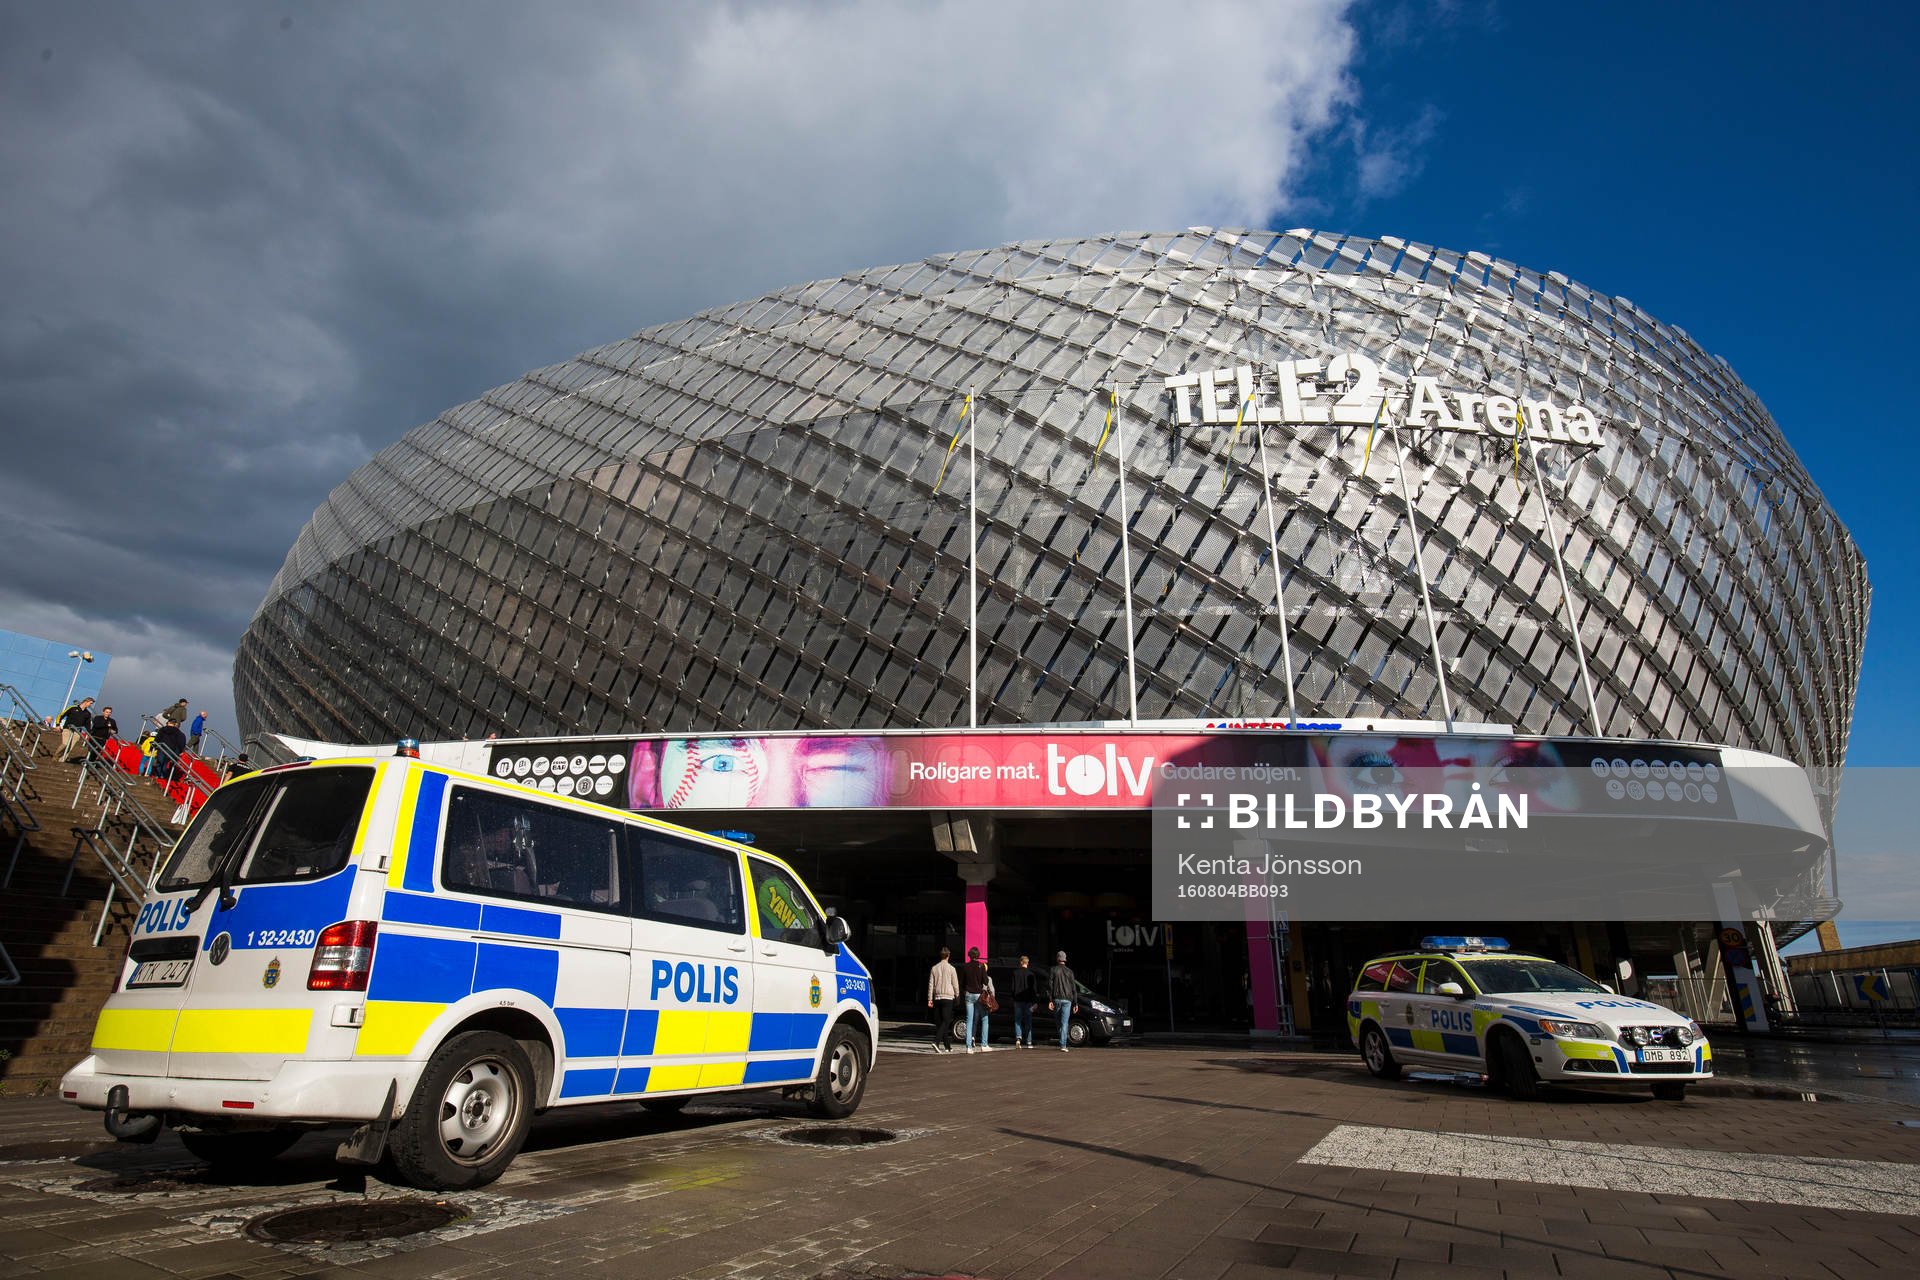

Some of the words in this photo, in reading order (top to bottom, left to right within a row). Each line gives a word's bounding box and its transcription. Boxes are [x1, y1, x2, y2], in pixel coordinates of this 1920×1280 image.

[1165, 353, 1388, 426] TELE2
[1405, 376, 1605, 447] Arena
[910, 762, 991, 783] Roligare
[996, 762, 1040, 779] mat.
[1047, 743, 1155, 796] tolv
[1160, 762, 1236, 780] Godare
[1241, 762, 1302, 784] nöjen.
[134, 896, 195, 935] POLIS
[247, 930, 255, 946] 1
[257, 929, 315, 946] 32-2430
[1107, 920, 1159, 946] tolv
[160, 962, 188, 981] 247
[650, 959, 739, 1005] POLIS
[1431, 1009, 1473, 1032] POLIS
[1644, 1050, 1664, 1061] DMB
[1669, 1050, 1688, 1061] 892
